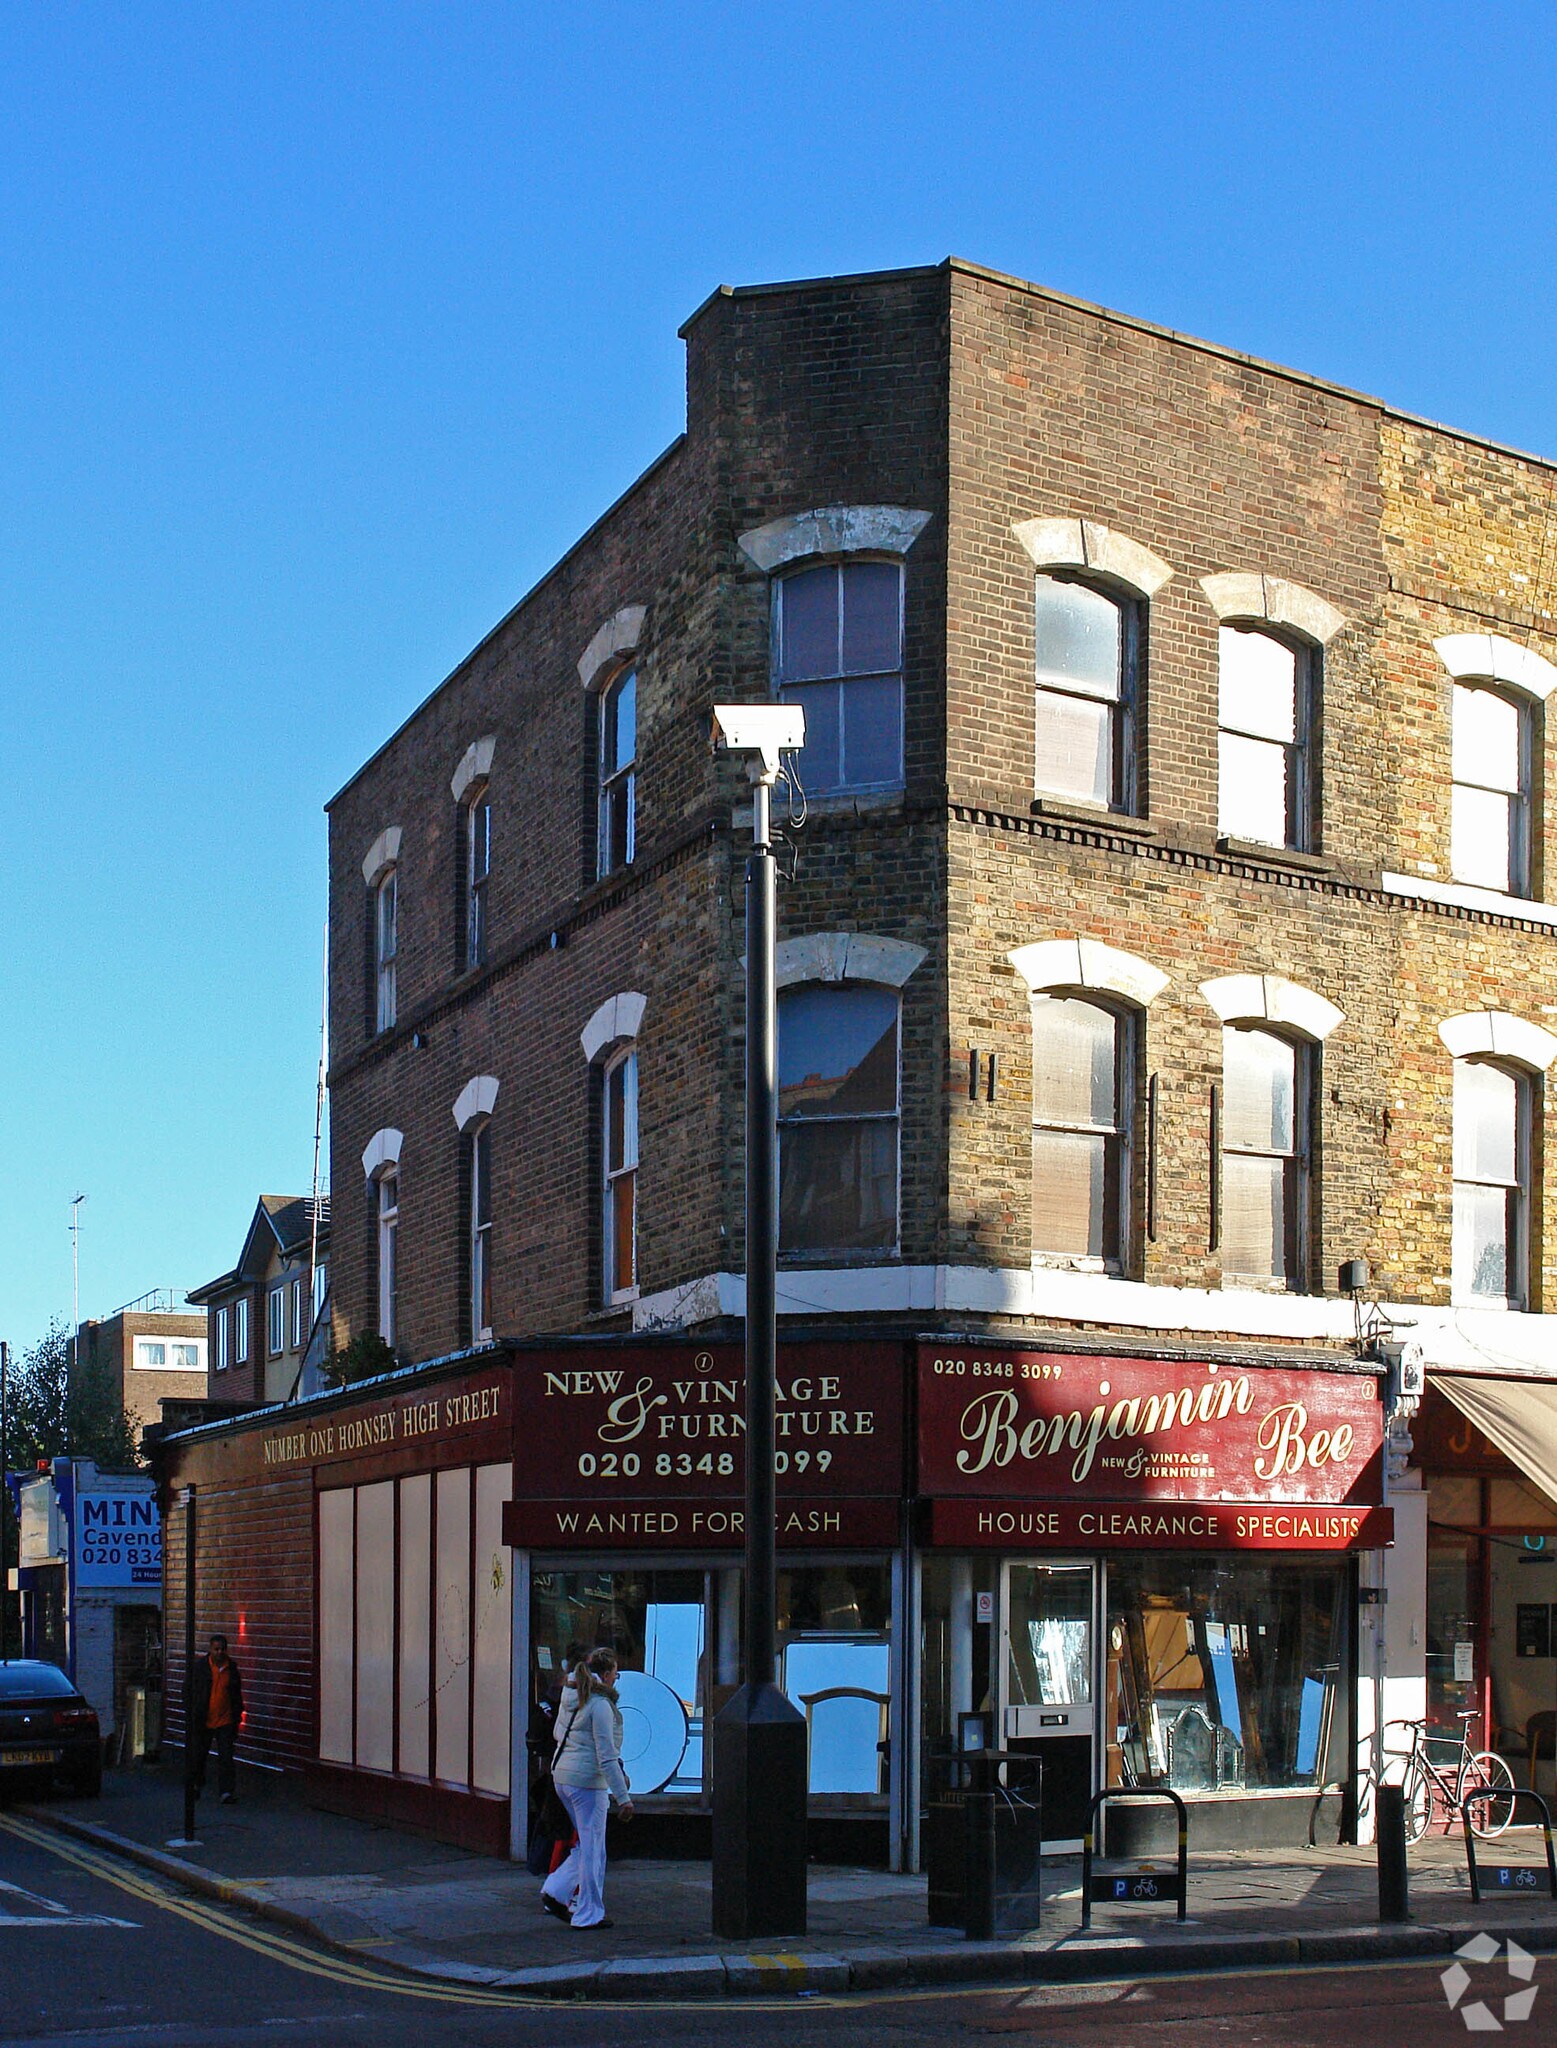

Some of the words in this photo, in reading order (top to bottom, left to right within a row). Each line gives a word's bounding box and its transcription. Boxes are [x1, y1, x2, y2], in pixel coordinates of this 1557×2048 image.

[934, 1359, 966, 1375] 020
[972, 1361, 1014, 1377] 8348
[1020, 1364, 1062, 1380] 3099
[543, 1370, 624, 1396] NEW
[597, 1376, 668, 1443] &
[672, 1376, 841, 1404] VINAGE
[264, 1431, 306, 1464] NUMBER
[310, 1426, 333, 1457] ONE
[338, 1411, 396, 1451] HORNSEY
[402, 1400, 438, 1437] HIGH
[446, 1385, 500, 1428] STREET
[657, 1411, 875, 1440] FURNTURE
[956, 1363, 1255, 1483] Benjamin
[1254, 1400, 1354, 1480] Bee
[578, 1453, 640, 1478] 020
[655, 1453, 734, 1476] 8348
[773, 1450, 833, 1474] 099
[1101, 1457, 1126, 1468] NEW
[1124, 1447, 1149, 1479] &
[1150, 1453, 1210, 1464] VINTAGE
[1144, 1466, 1216, 1478] FURNITURE
[556, 1512, 678, 1533] WANTED
[693, 1512, 746, 1533] FOR
[773, 1511, 841, 1532] ASH
[978, 1512, 1060, 1533] HOUSE
[1078, 1514, 1218, 1536] CLEARANCE
[1236, 1516, 1359, 1538] SPECIALISTS
[82, 1548, 122, 1565] 020
[1115, 1880, 1126, 1896] P
